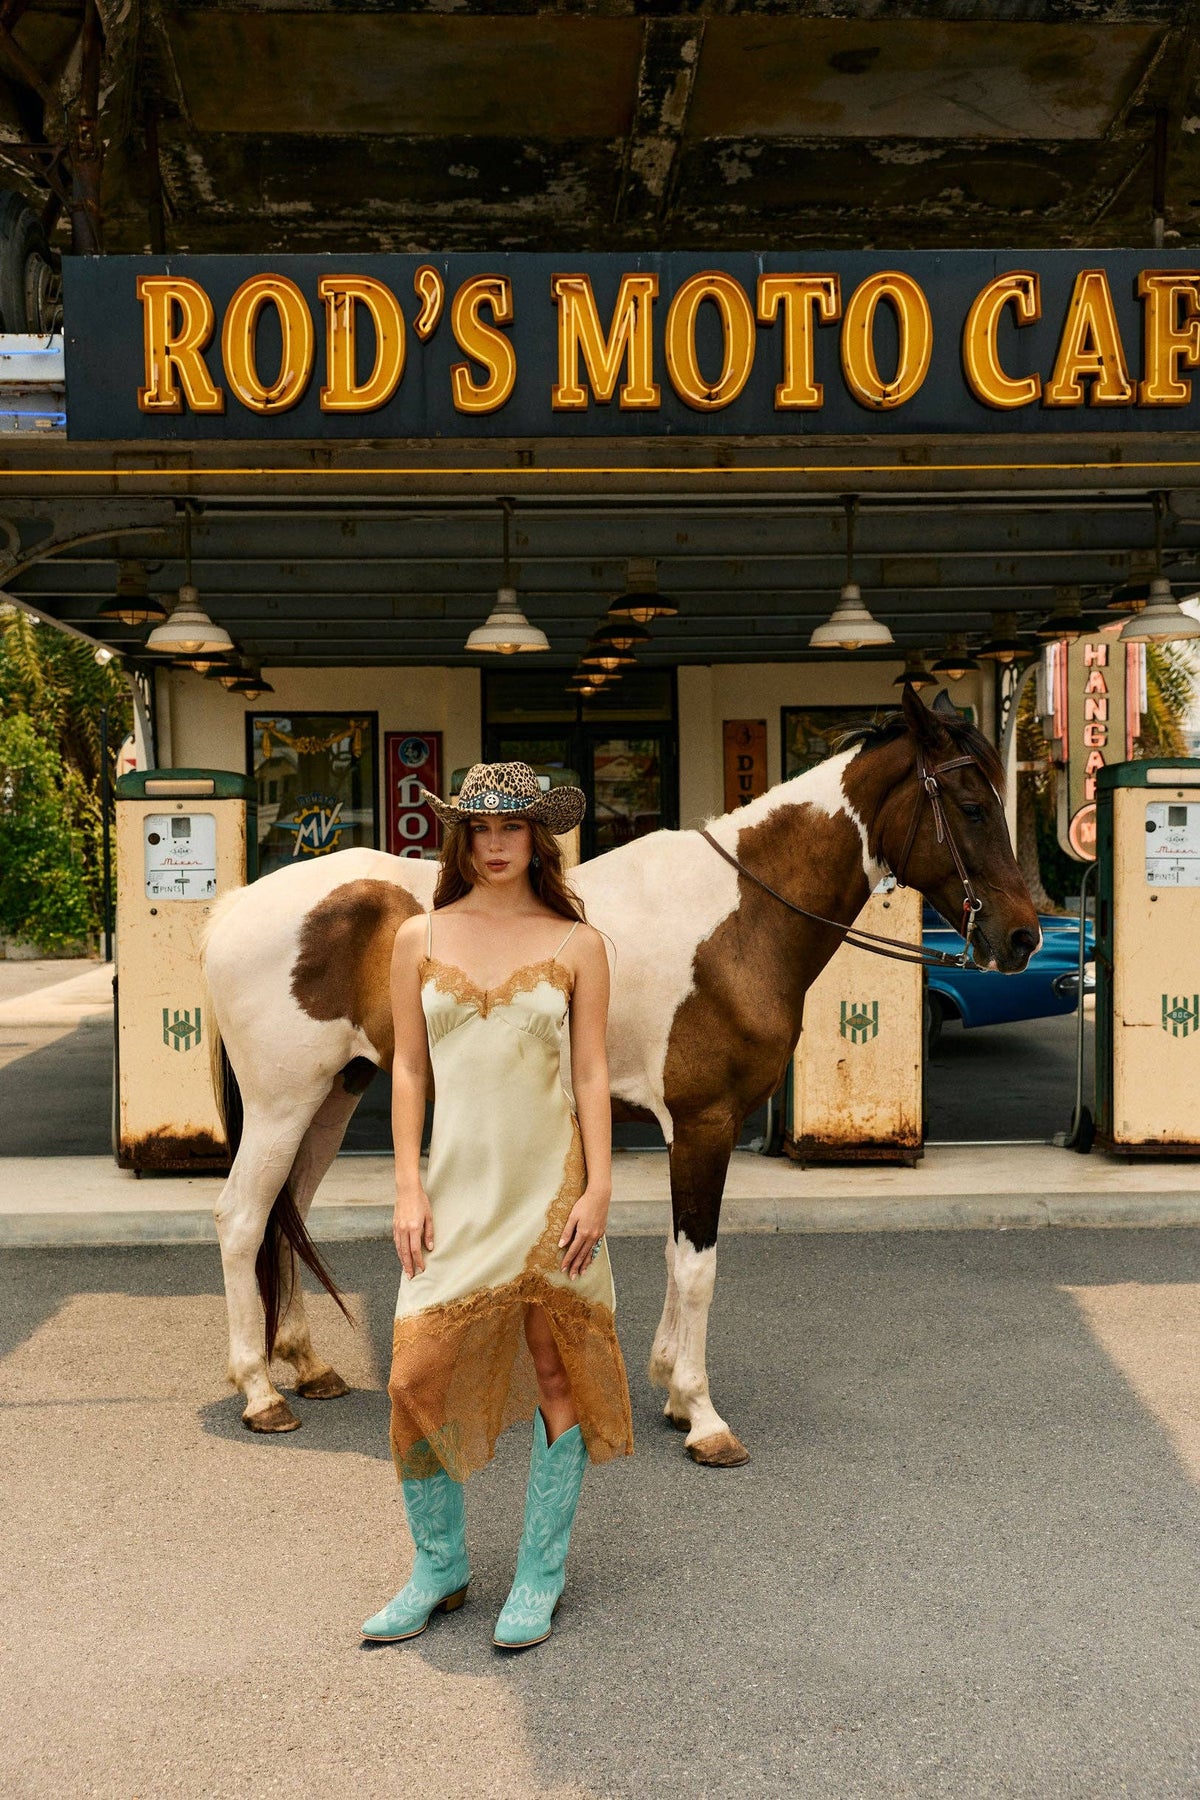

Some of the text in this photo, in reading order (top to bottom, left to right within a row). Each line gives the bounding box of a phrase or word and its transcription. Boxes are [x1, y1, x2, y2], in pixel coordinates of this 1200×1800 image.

[136, 264, 517, 414] ROD'S
[551, 270, 933, 412] MOTO
[292, 802, 344, 857] MV
